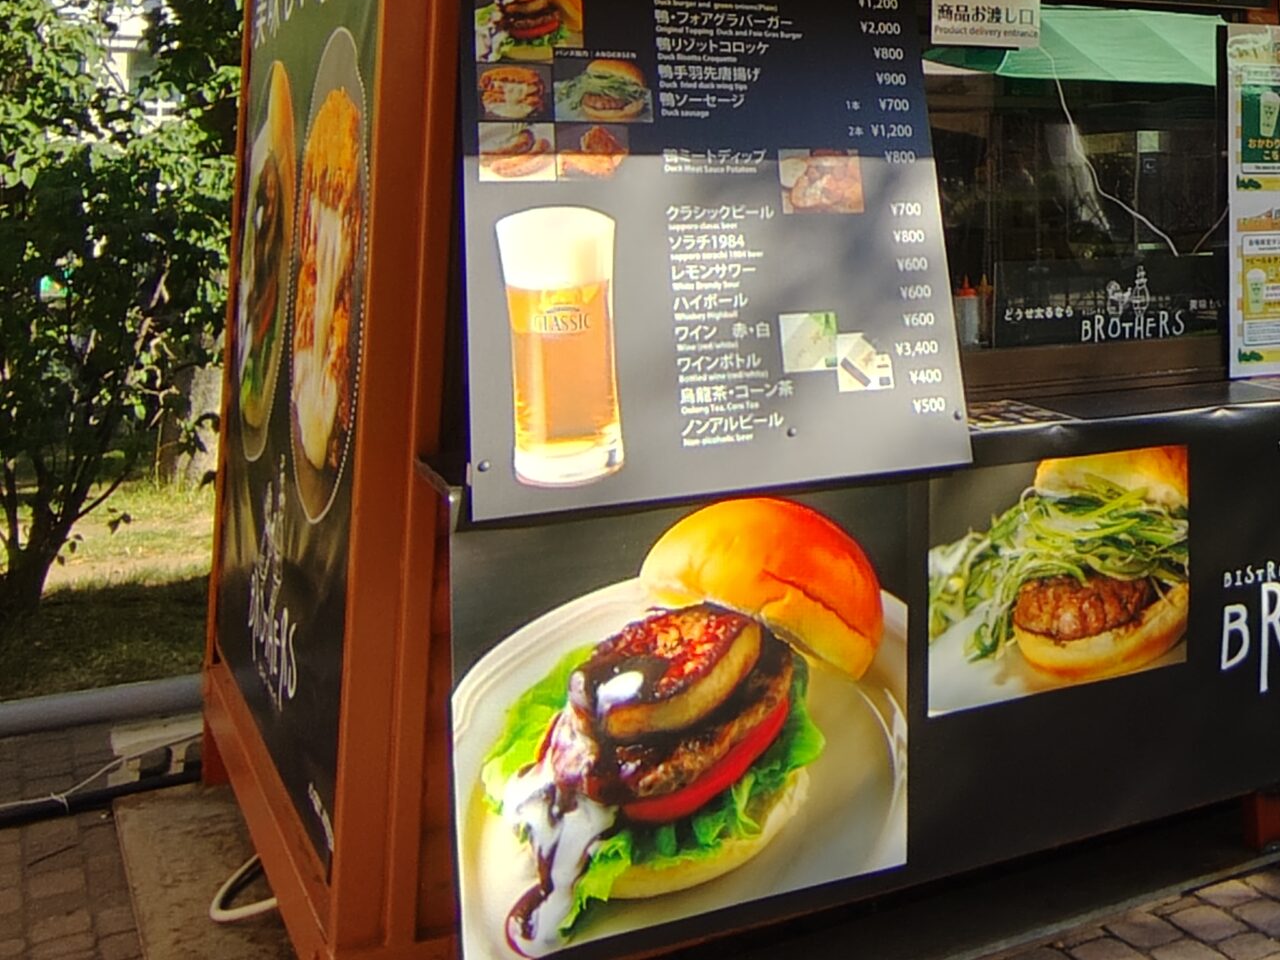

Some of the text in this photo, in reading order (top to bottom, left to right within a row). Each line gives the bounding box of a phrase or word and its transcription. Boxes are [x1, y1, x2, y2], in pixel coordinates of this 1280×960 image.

[937, 3, 1035, 26] 商品お渡し口
[860, 21, 901, 35] ¥2,000
[934, 26, 1038, 39] Product delivery entrance
[656, 36, 904, 60] 鴨リゾットコロッケ ¥800
[876, 72, 907, 86] ¥900
[659, 92, 746, 109] 鴨ソーセージ
[879, 98, 910, 111] ¥700
[871, 124, 913, 139] ¥1,200
[885, 150, 916, 164] ¥800
[666, 202, 922, 221] クラシックビール ¥700
[668, 230, 925, 251] ソラチ1984 ¥800
[671, 257, 929, 281] レモンサワー ¥600
[673, 285, 932, 311] ハイボール ¥600
[674, 324, 717, 341] ワイン
[903, 312, 935, 327] ¥600
[1081, 310, 1185, 343] BROTHERS
[676, 340, 939, 372] ワインボトル ¥3,400
[909, 369, 942, 385] ¥400
[682, 397, 946, 437] ノンアルビール ¥500
